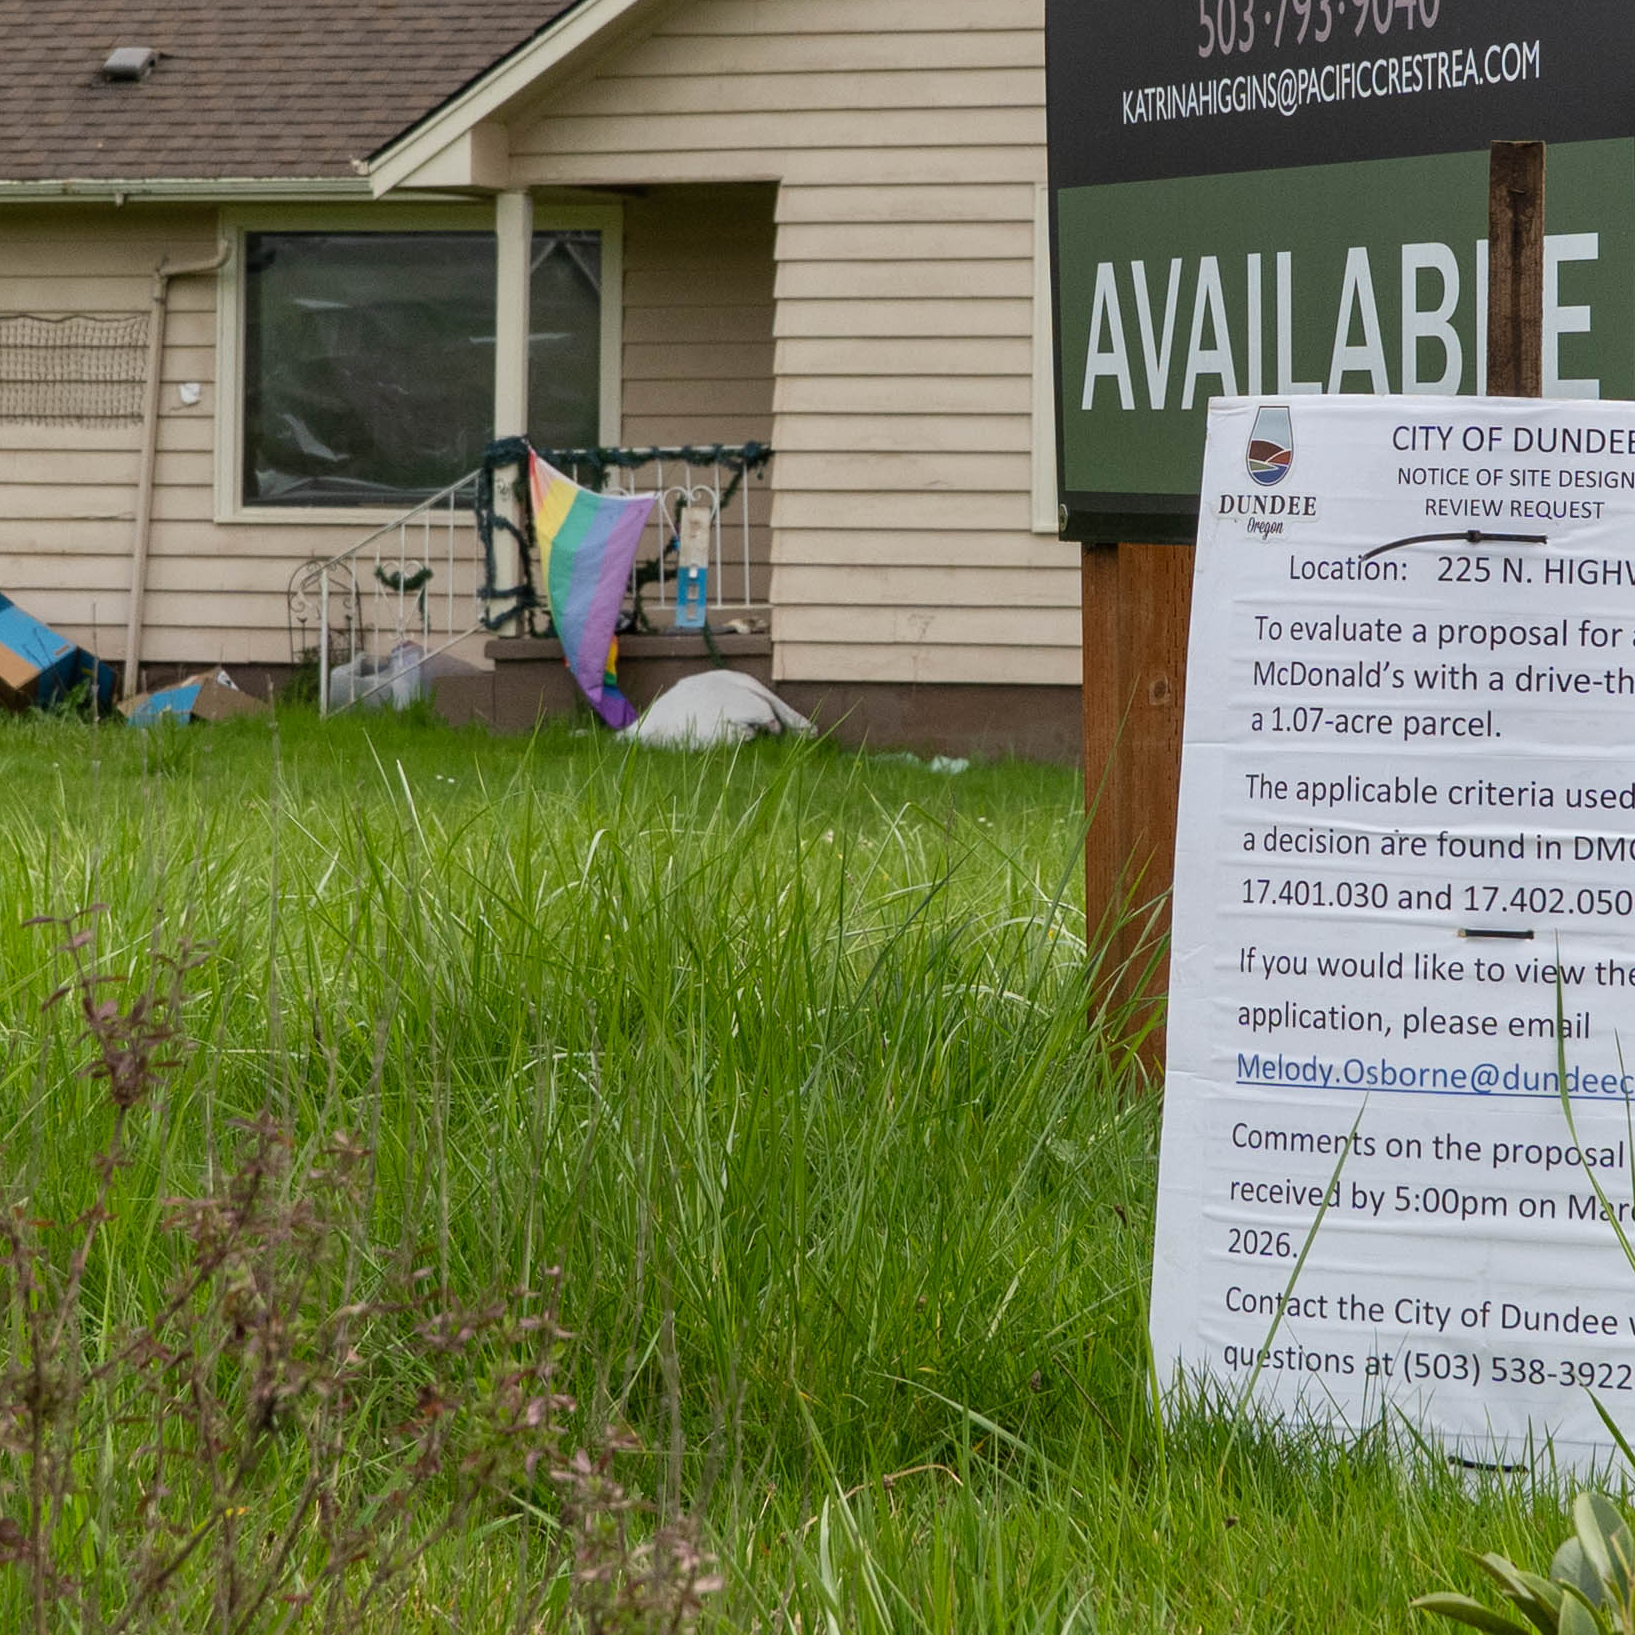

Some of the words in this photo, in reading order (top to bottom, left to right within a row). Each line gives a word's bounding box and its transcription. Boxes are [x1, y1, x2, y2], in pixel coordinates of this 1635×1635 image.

[1123, 40, 1539, 124] KATRINAHIGGINS@PACIFICCRESTREA.COM
[1393, 426, 1453, 451] CITY
[1463, 426, 1502, 452] OF
[1399, 468, 1469, 485] NOTICE
[1476, 469, 1503, 486] OF
[1510, 469, 1551, 487] SITE
[1559, 470, 1634, 489] DESIGN
[1219, 495, 1316, 516] DUNDEE
[1426, 498, 1503, 516] REVIEW
[1511, 500, 1605, 520] REQUEST
[1247, 517, 1283, 540] Oregon
[1290, 555, 1407, 580] Location:
[1438, 556, 1490, 582] 225
[1503, 558, 1531, 583] N.
[1255, 616, 1282, 640] To
[1290, 614, 1402, 642] evaluate
[1412, 624, 1426, 643] a
[1439, 619, 1567, 652] proposal
[1578, 620, 1623, 647] for
[1414, 663, 1477, 690] with
[1489, 672, 1503, 691] a
[1252, 713, 1263, 731] a
[1272, 706, 1392, 734] 1.07-acre
[1404, 710, 1500, 741] parcel.
[1246, 773, 1287, 799] The
[1296, 775, 1437, 809] applicable
[1449, 780, 1553, 807] criteria
[1567, 782, 1635, 809] used
[1243, 833, 1255, 851] a
[1263, 827, 1369, 856] decision
[1380, 837, 1426, 858] are
[1436, 831, 1524, 859] found
[1537, 835, 1561, 860] in
[1243, 879, 1388, 908] 17.401.030
[1398, 884, 1451, 910] and
[1241, 947, 1256, 972] If
[1262, 955, 1307, 980] you
[1317, 952, 1403, 979] would
[1415, 953, 1464, 981] like
[1474, 958, 1505, 982] to
[1515, 958, 1585, 984] view
[1238, 1002, 1391, 1038] application,
[1403, 1007, 1498, 1040] please
[1509, 1012, 1590, 1038] email
[1232, 1123, 1375, 1156] Comments
[1386, 1138, 1421, 1159] on
[1432, 1133, 1481, 1161] the
[1492, 1140, 1624, 1171] proposal
[1230, 1179, 1340, 1208] received
[1352, 1181, 1385, 1216] by
[1395, 1186, 1507, 1221] 5:00pm
[1519, 1198, 1555, 1218] on
[1228, 1228, 1297, 1258] 2026.
[1225, 1286, 1327, 1319] Contact
[1337, 1294, 1384, 1322] the
[1395, 1298, 1451, 1332] City
[1461, 1301, 1491, 1328] of
[1502, 1304, 1618, 1335] Dundee
[1224, 1344, 1354, 1372] questions
[1365, 1352, 1393, 1377] at
[1404, 1350, 1480, 1386] (503)
